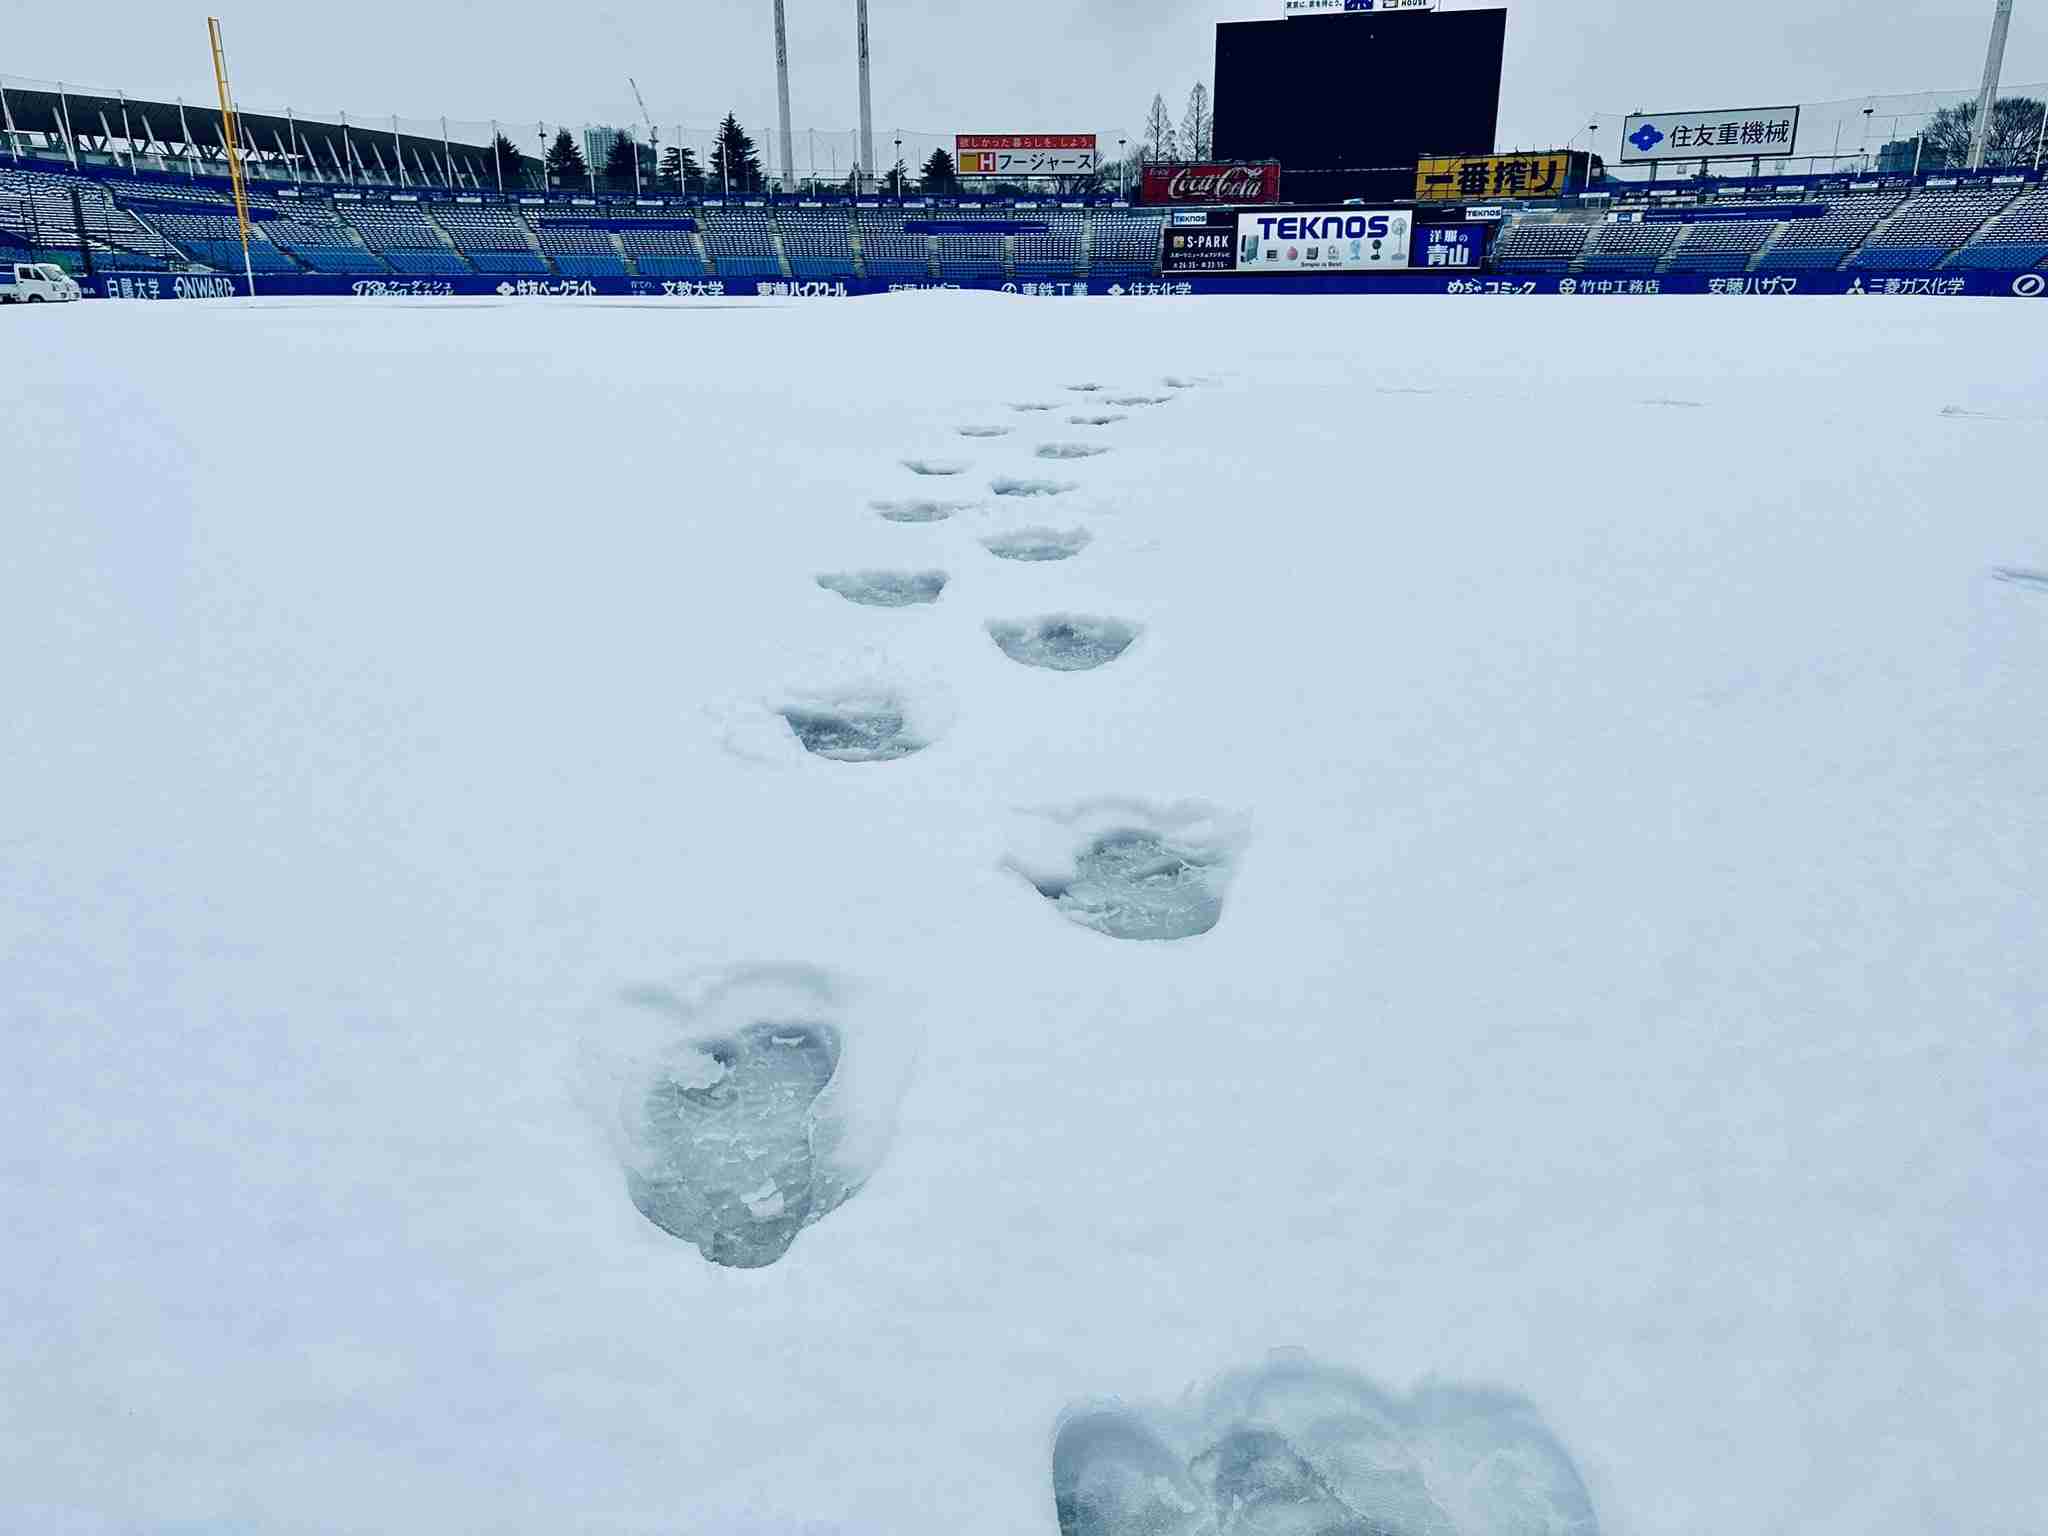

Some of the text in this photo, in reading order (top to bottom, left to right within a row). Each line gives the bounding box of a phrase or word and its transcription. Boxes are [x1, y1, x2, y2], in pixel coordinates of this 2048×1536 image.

[1670, 119, 1789, 148] 住友重機械
[998, 153, 1092, 171] フージャース
[1425, 160, 1557, 195] 一番搾り
[1467, 209, 1501, 217] TEKNOS
[1257, 216, 1389, 240] TEKNOS
[1430, 230, 1468, 242] 洋服の
[1187, 235, 1229, 248] S-PARK
[1427, 244, 1469, 265] 青山
[173, 277, 235, 298] ONWARD
[517, 280, 597, 296] 住友ベークライト
[661, 280, 725, 296] 文教大学
[1128, 282, 1192, 296] 住友化学
[1580, 280, 1660, 294] 竹中工務店
[1708, 276, 1797, 295] 安藤ハザマ
[1869, 277, 1965, 295] 三菱ガス化学
